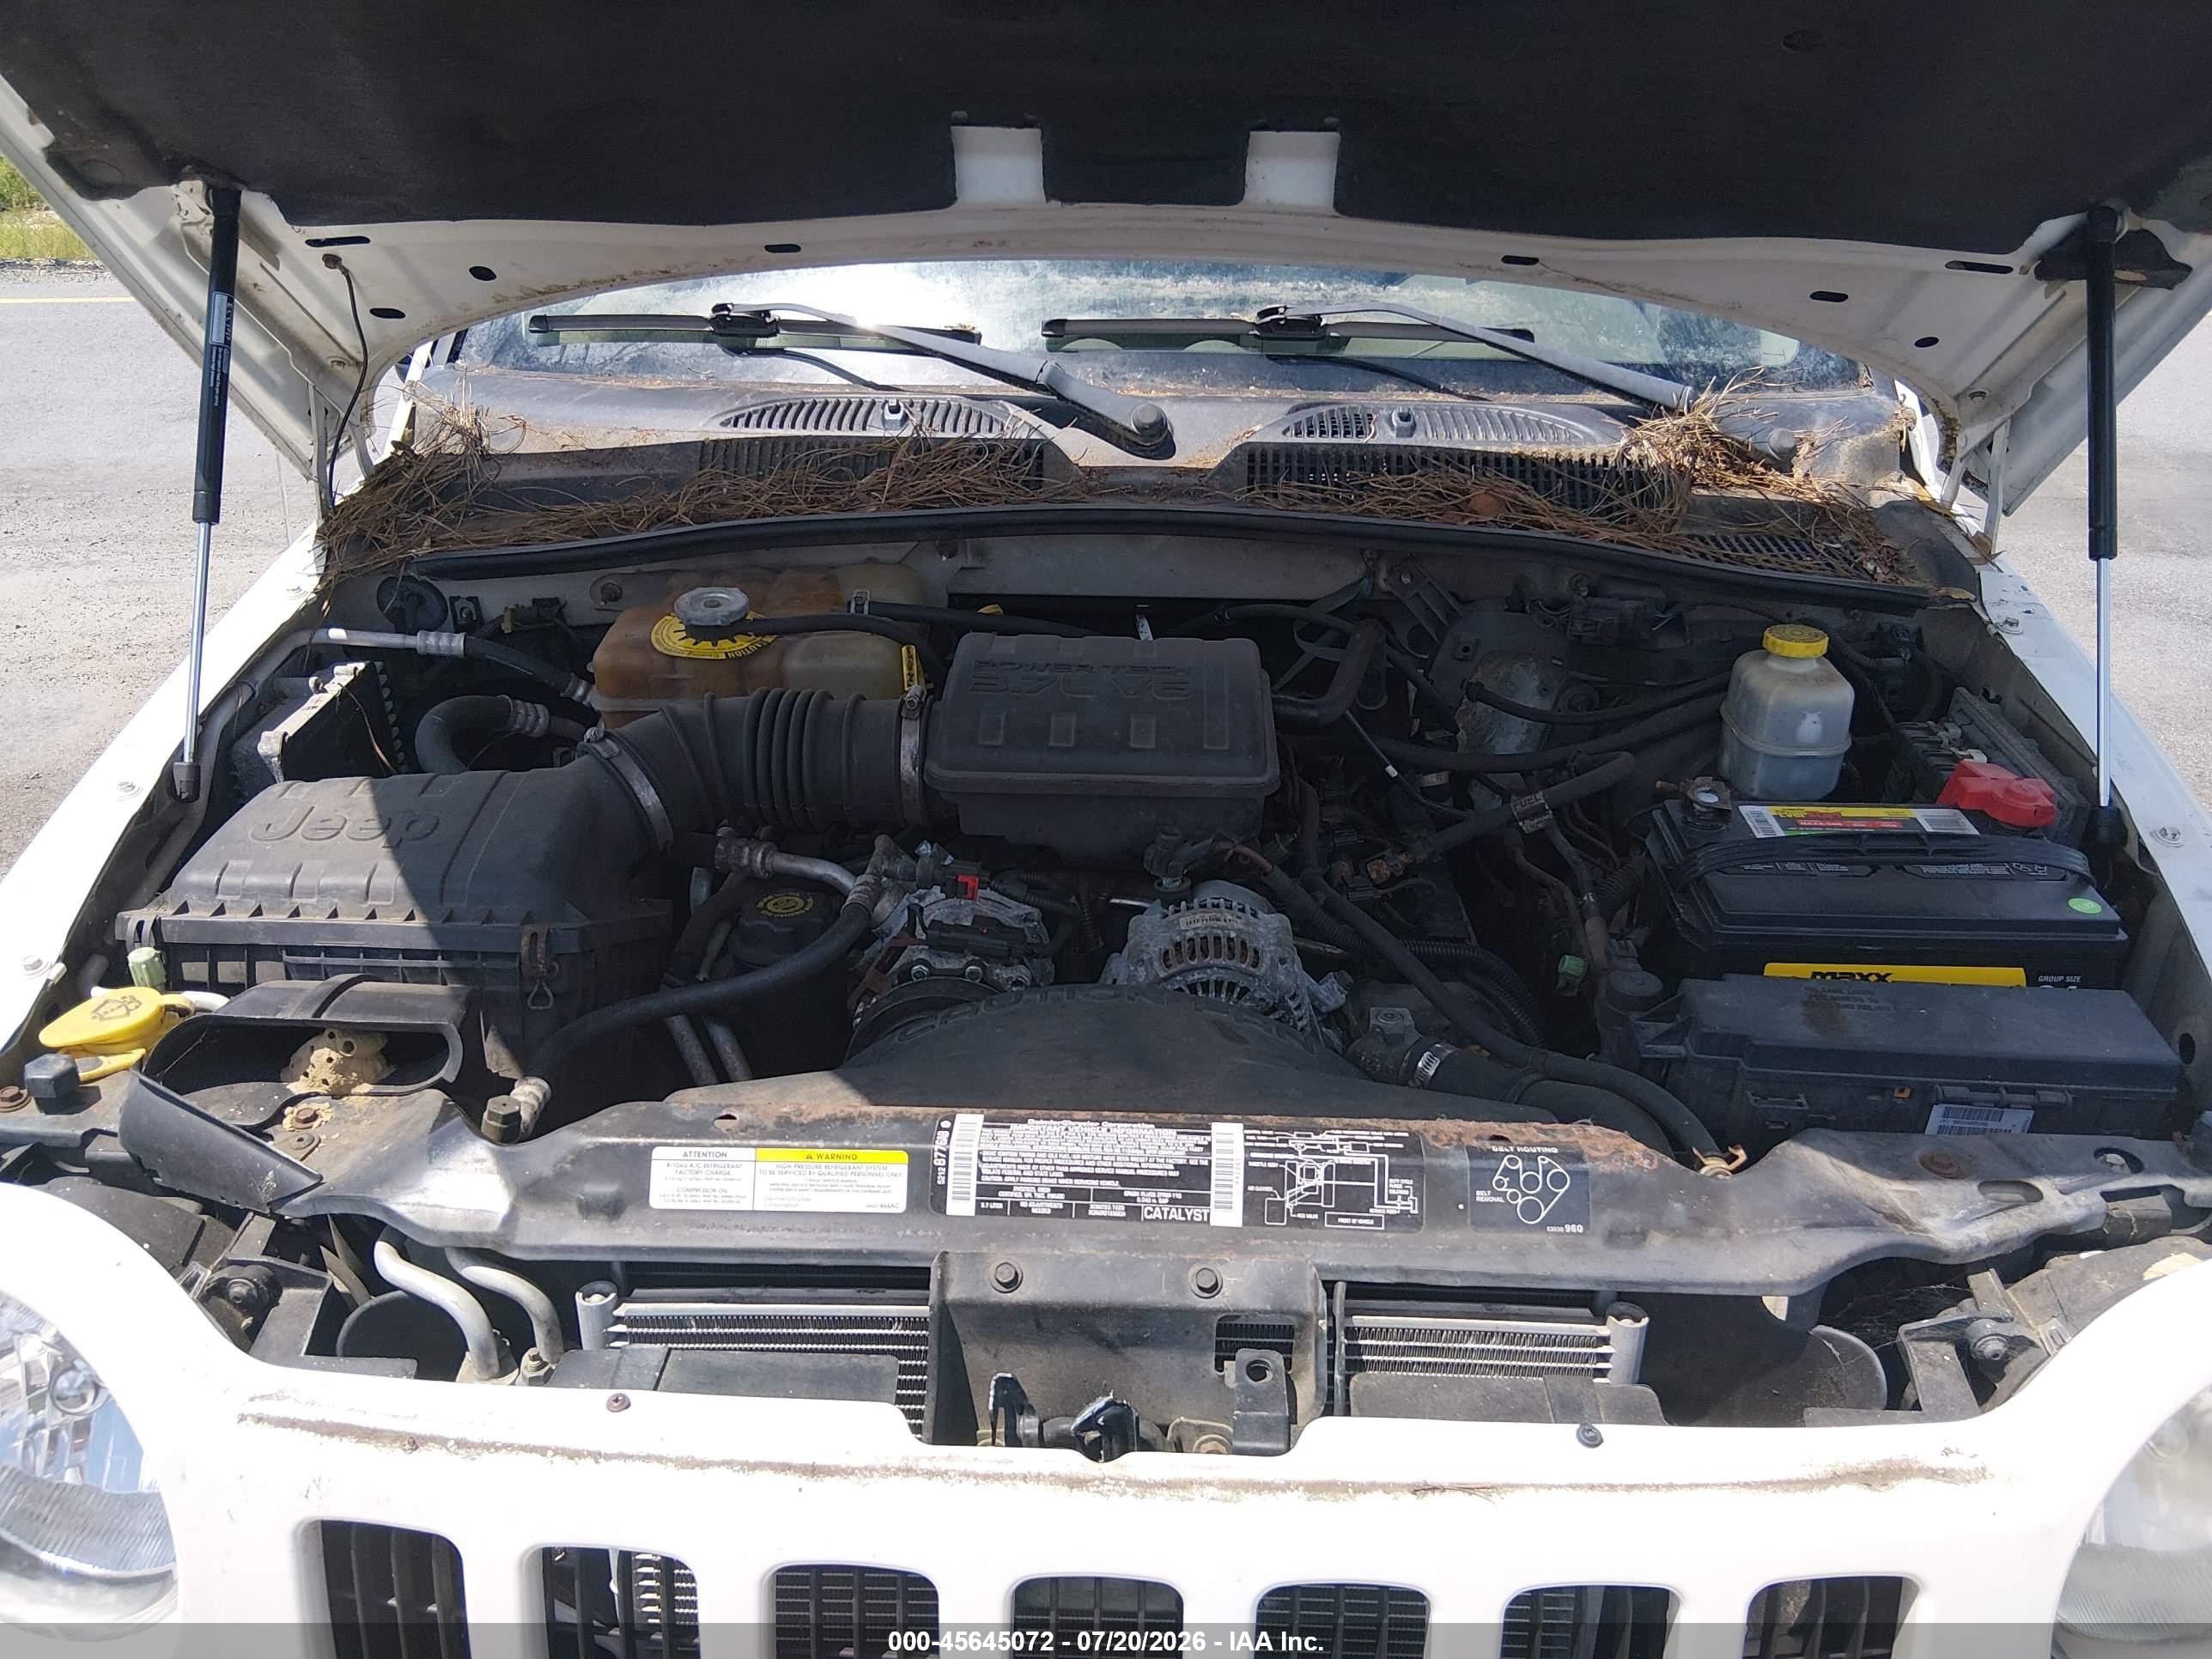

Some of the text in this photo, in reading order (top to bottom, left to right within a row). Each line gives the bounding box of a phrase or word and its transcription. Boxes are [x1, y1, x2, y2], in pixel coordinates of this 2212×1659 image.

[249, 805, 441, 849] Jeep
[816, 1152, 858, 1161] WARNING
[1144, 1206, 1210, 1221] CATALYST
[1565, 1224, 1583, 1233] 960
